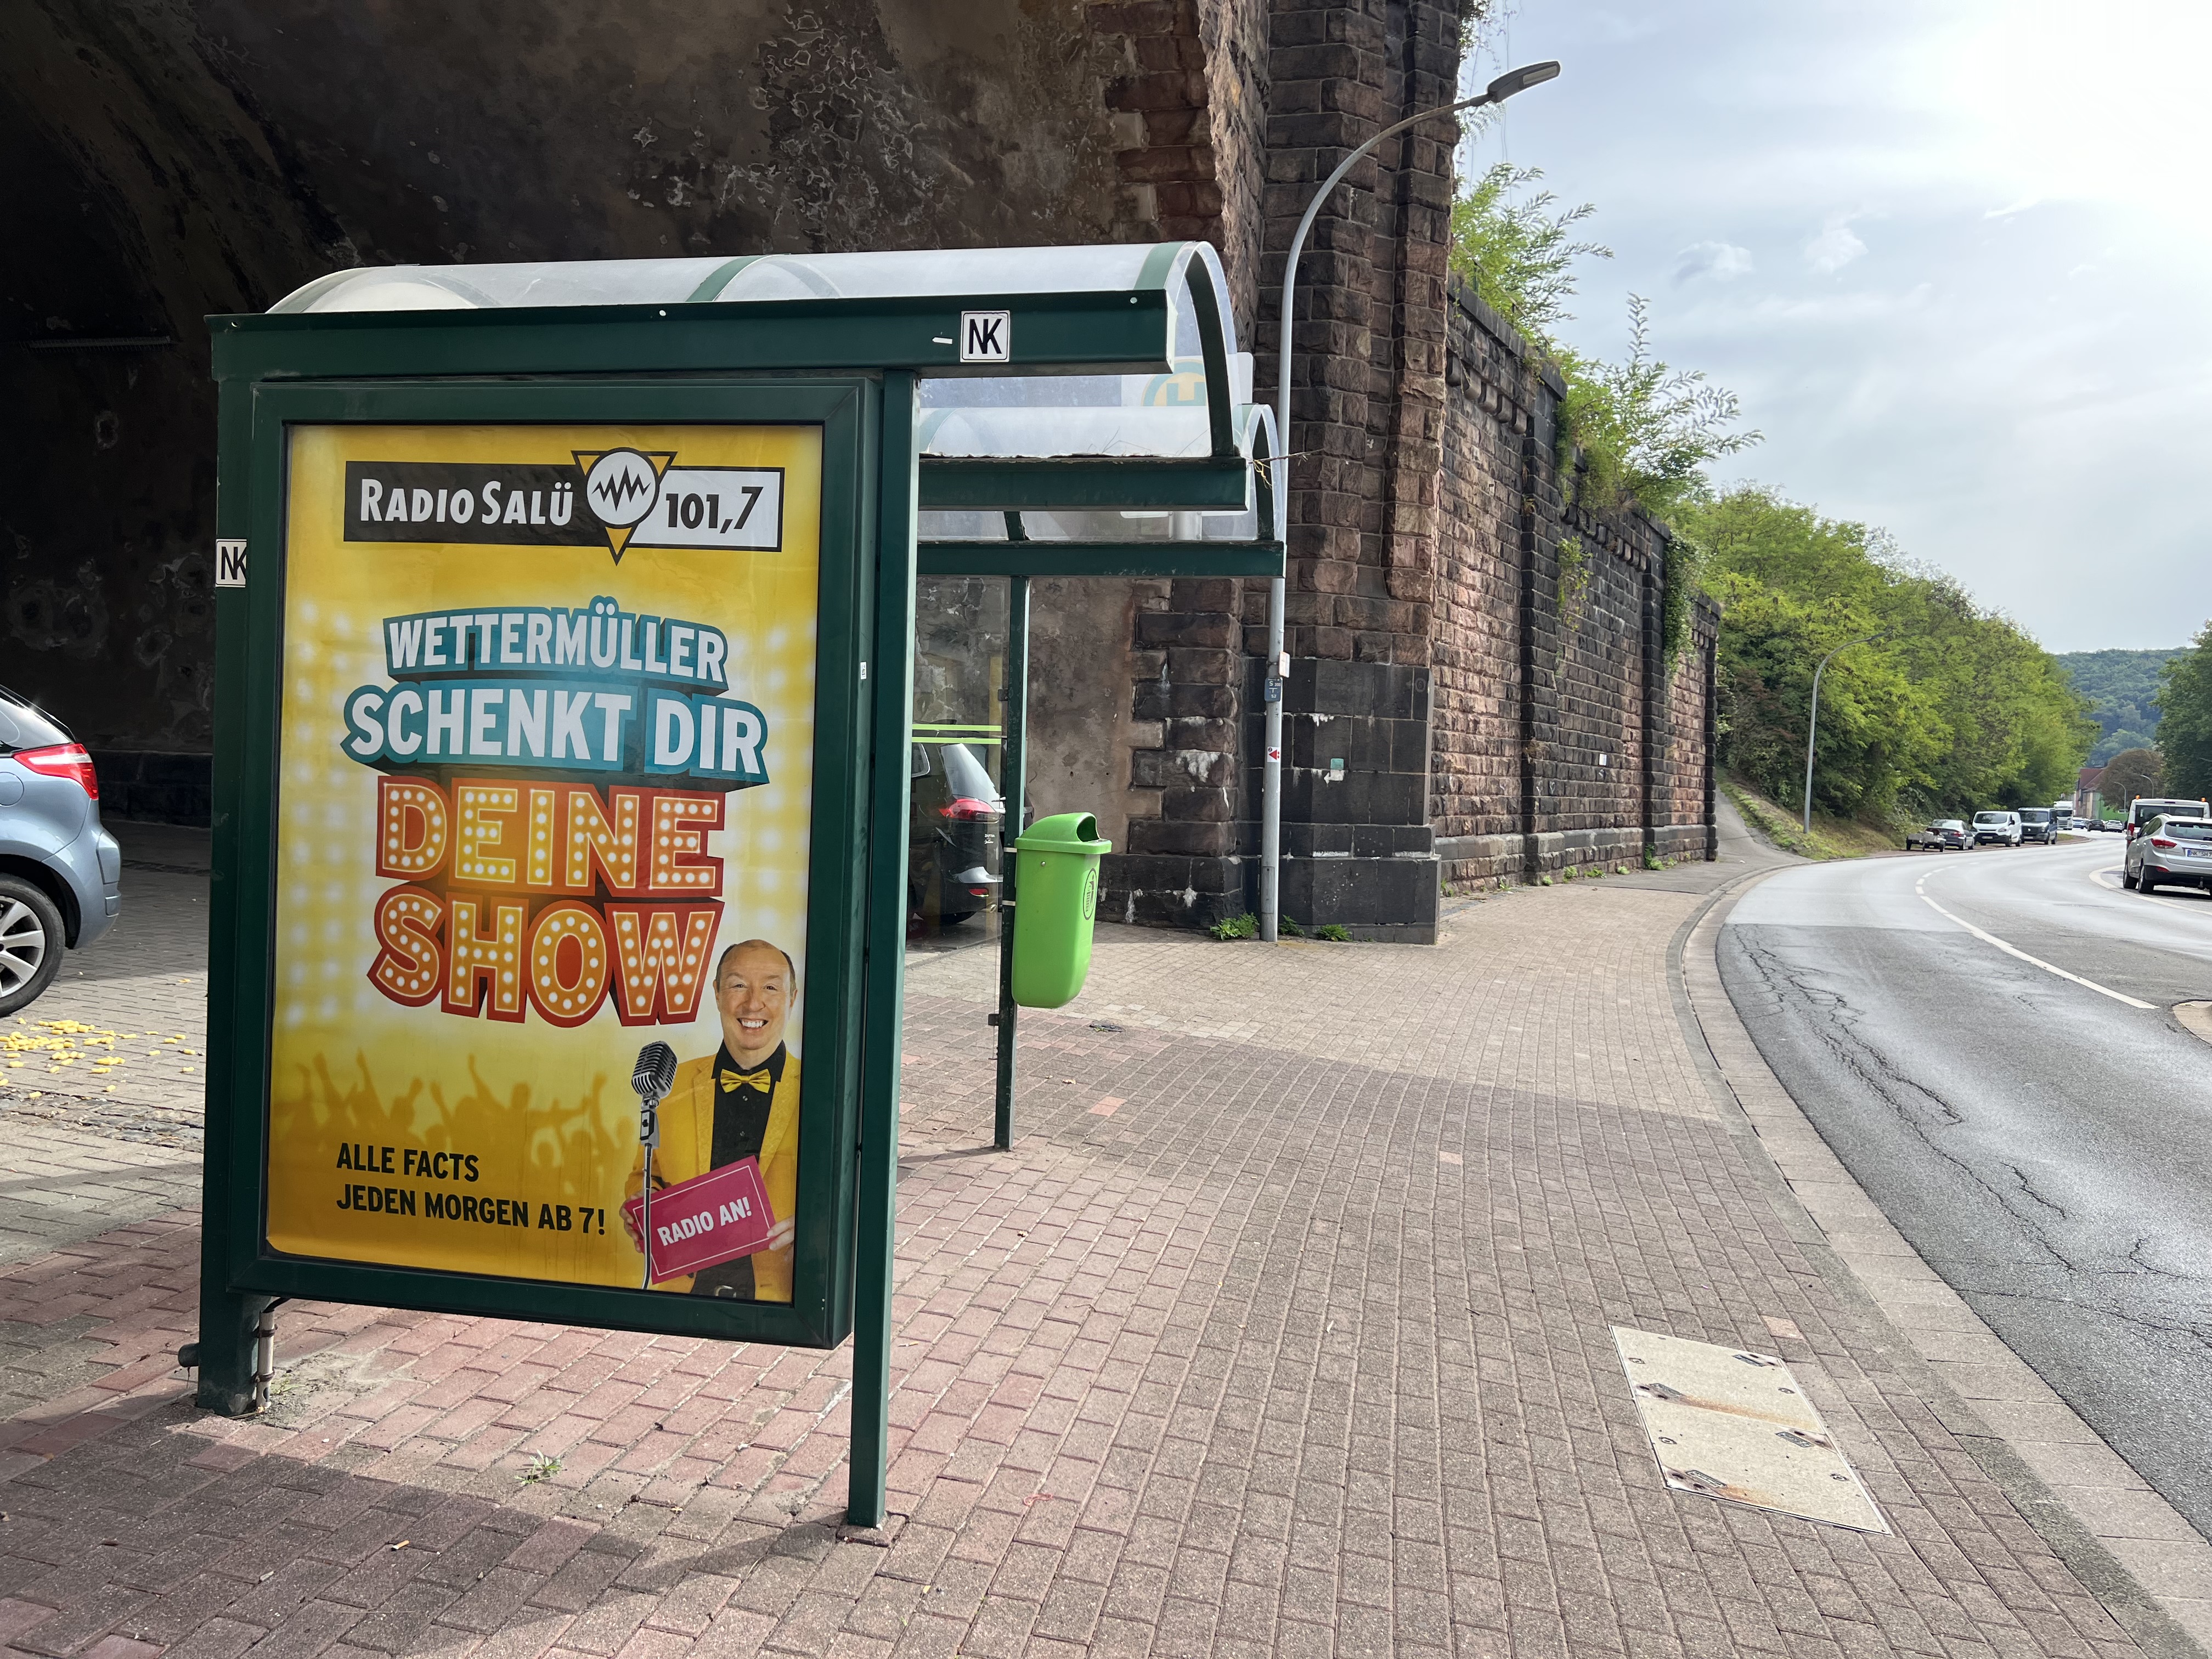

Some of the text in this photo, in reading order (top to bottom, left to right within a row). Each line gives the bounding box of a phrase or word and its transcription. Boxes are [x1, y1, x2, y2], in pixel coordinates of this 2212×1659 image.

[968, 318, 1002, 354] NK
[665, 486, 763, 534] 101,7
[221, 546, 247, 580] NK
[389, 602, 725, 682] WETTERMÜLLER
[349, 687, 761, 775] SCHENKT DIR
[380, 782, 719, 890] DEINE
[375, 892, 716, 1019] SHOW
[336, 1142, 479, 1182] ALLE FACTS
[336, 1183, 606, 1235] JEDEN MORGEN AB 7!
[656, 1196, 753, 1247] RADIO AN!
